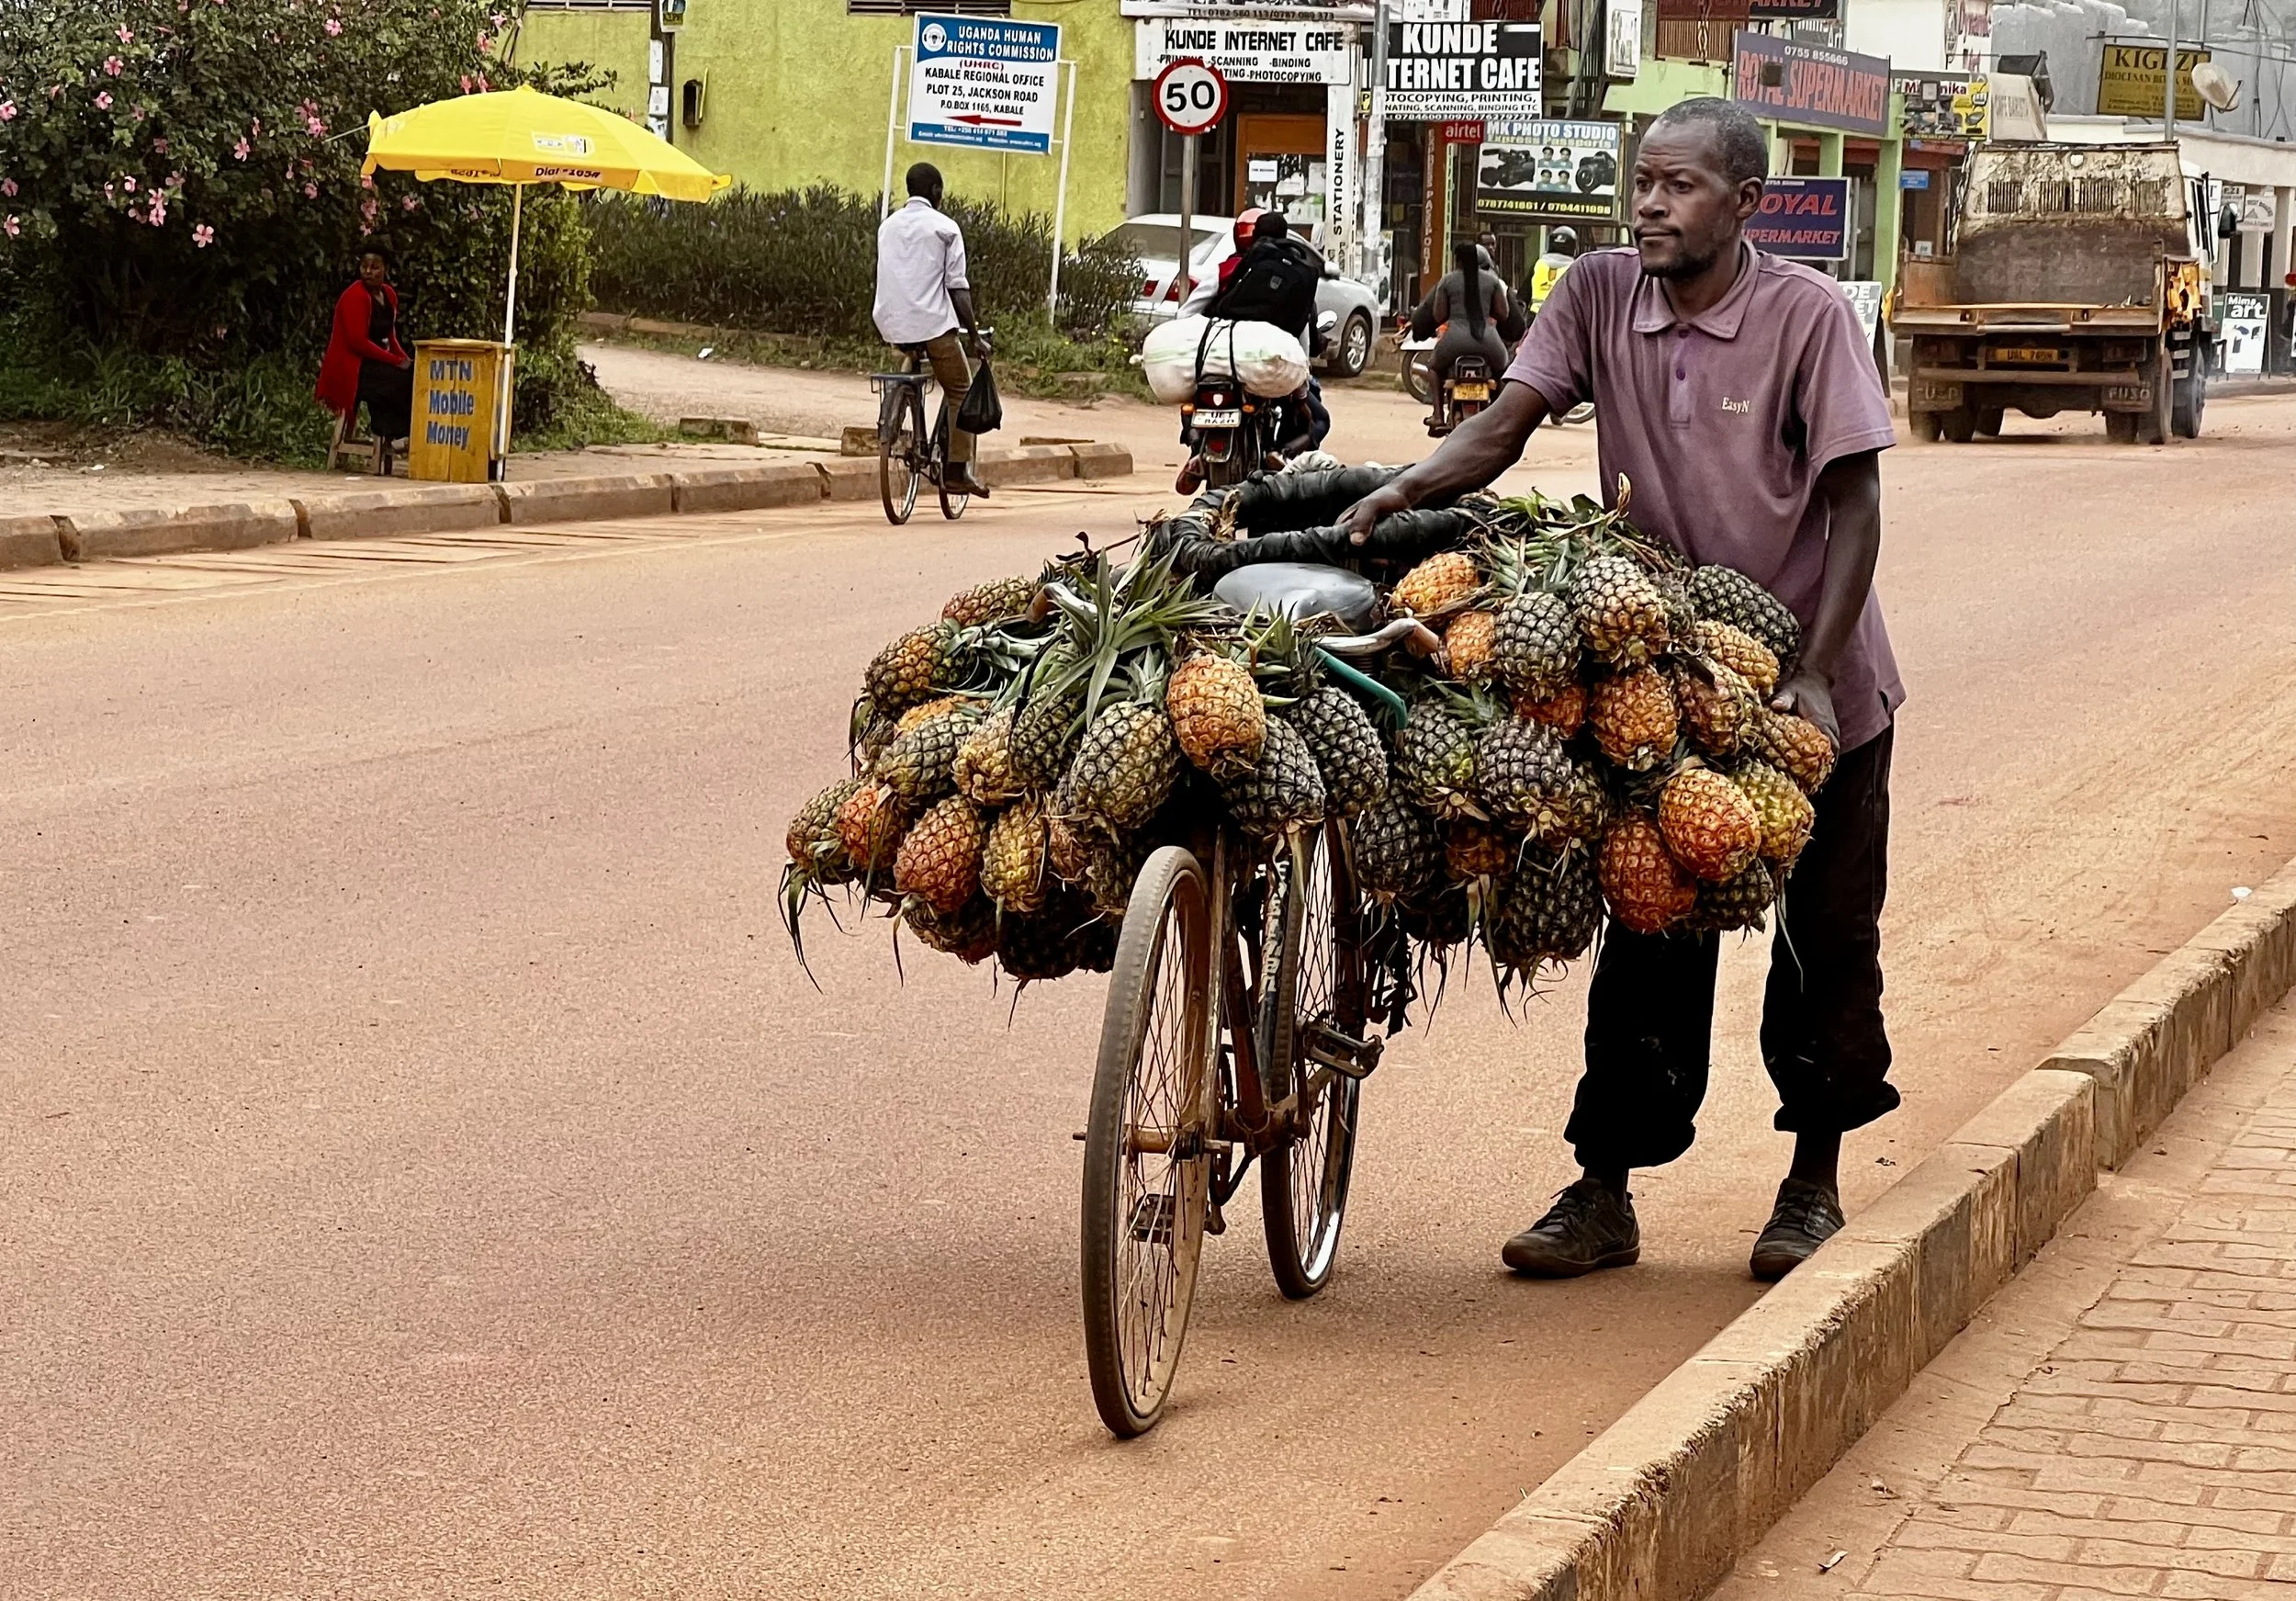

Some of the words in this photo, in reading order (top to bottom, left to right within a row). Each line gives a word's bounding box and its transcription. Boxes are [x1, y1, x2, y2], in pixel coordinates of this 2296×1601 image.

[959, 26, 999, 41] UGANDA
[1004, 28, 1041, 44] HUMAN
[1165, 29, 1216, 50] KUNDE
[1225, 31, 1297, 51] INTERNET
[1305, 32, 1344, 51] CAFE
[1402, 23, 1498, 53] KUNDE
[947, 40, 985, 55] RIGHTS
[988, 43, 1053, 61] COMMISSION
[960, 60, 1005, 72] (UHRC)
[1219, 68, 1244, 78] TING
[1480, 57, 1540, 90] CAFE
[925, 68, 961, 80] KABALE
[964, 70, 1009, 84] REGIONAL
[1012, 74, 1044, 86] OFFICE
[927, 84, 950, 96] PLOT
[952, 85, 965, 98] 25,
[968, 87, 1011, 100] JACKSON
[1014, 91, 1038, 103] ROAD
[1166, 80, 1215, 112] 50
[1363, 94, 1469, 105] PTOCOPYING,
[1471, 93, 1537, 103] PRINTING,
[1787, 60, 1888, 121] SUPERMARKET
[940, 100, 969, 110] P.O.BOX
[994, 105, 1024, 115] KABALE
[1446, 122, 1480, 138] airtel
[1487, 121, 1510, 136] MK
[1513, 123, 1560, 138] PHOTO
[1563, 125, 1616, 141] STUDIO
[1334, 128, 1345, 235] STATIONERY
[1760, 193, 1838, 217] OYAL
[1744, 230, 1840, 244] UPERMARKET
[2231, 302, 2264, 318] art
[430, 359, 472, 381] MTN
[429, 389, 474, 415] Mobile
[1721, 397, 1750, 413] EasyN
[426, 421, 470, 451] Money
